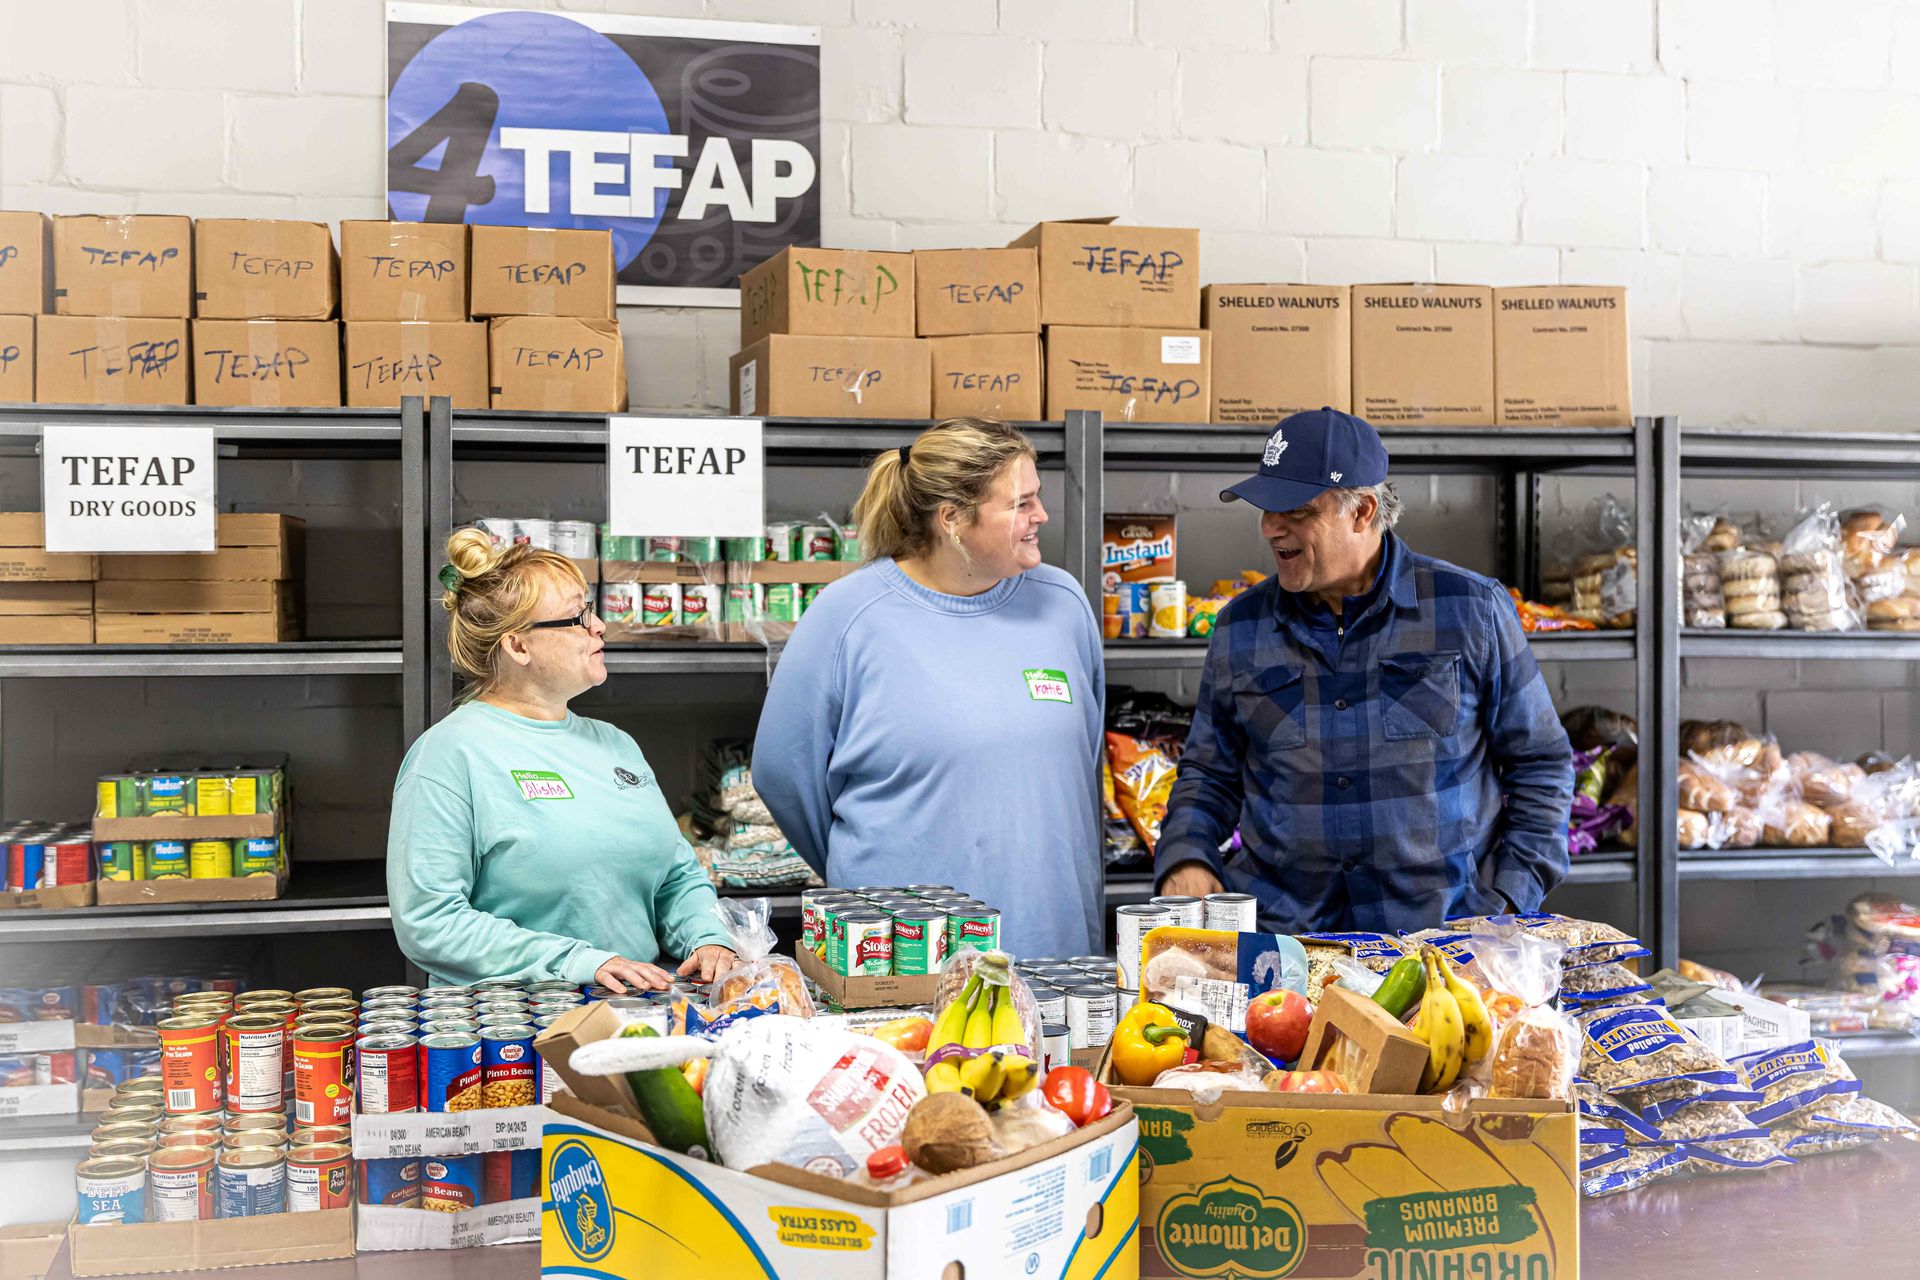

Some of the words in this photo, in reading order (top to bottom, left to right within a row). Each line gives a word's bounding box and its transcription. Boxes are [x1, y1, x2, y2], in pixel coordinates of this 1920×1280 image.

[388, 82, 499, 224] 4
[500, 126, 816, 223] TEFAP
[81, 246, 178, 271] TEFAP
[231, 251, 313, 279] TEFAP
[364, 255, 455, 281] TEFAP
[1082, 246, 1183, 281] TEFAP
[499, 262, 586, 285] TEFAP
[941, 282, 1024, 305] TEFAP
[1219, 296, 1274, 308] SHELLED
[1278, 297, 1340, 308] WALNUTS
[1365, 297, 1419, 308] SHELLED
[1423, 297, 1482, 308] WALNUTS
[1501, 299, 1554, 310] SHELLED
[1557, 297, 1616, 309] WALNUTS
[512, 347, 603, 371] TEFAP
[352, 353, 442, 389] TEFAP
[946, 372, 1021, 392] TEFAP
[1100, 375, 1200, 403] TEFAP
[62, 456, 195, 486] TEFAP
[626, 446, 746, 476] TEFAP
[70, 500, 115, 517] DRY
[121, 500, 196, 517] GOODS
[1105, 540, 1170, 564] Instant
[153, 780, 182, 790] Hudson
[520, 780, 566, 798] Alisha
[155, 844, 184, 854] Hudson
[249, 841, 275, 851] Hudson
[963, 922, 993, 933] Stokely's
[1743, 1013, 1779, 1033] PAGHETTI
[1599, 1023, 1675, 1050] WALNUTS
[503, 1047, 522, 1055] American
[487, 1069, 510, 1079] Pinto
[511, 1068, 534, 1076] Beans
[1749, 1051, 1820, 1079] WALNUTS
[460, 1074, 479, 1087] Pinto
[727, 1071, 746, 1127] frozen
[859, 1077, 918, 1150] FROZEN
[425, 1128, 451, 1138] AMERICAN
[452, 1125, 471, 1138] BEAUTY
[389, 1145, 404, 1155] PINTO
[405, 1144, 422, 1155] BEANS
[331, 1167, 345, 1179] Pink
[551, 1159, 602, 1204] Chiquita
[87, 1185, 129, 1198] DEEP
[434, 1187, 463, 1198] Beans
[92, 1199, 122, 1211] SEA
[1205, 1202, 1257, 1222] Quality
[1400, 1194, 1499, 1221] BANANAS
[488, 1214, 514, 1226] AMERICAN
[516, 1211, 535, 1223] BEAUTY
[779, 1214, 818, 1229] EXTRA
[820, 1218, 857, 1232] CLASS
[781, 1232, 818, 1246] QUALITY
[1168, 1222, 1249, 1250] Monte
[1252, 1226, 1293, 1252] Del
[1404, 1215, 1500, 1243] PREMIUM
[467, 1233, 484, 1246] BEANS
[819, 1235, 863, 1249] SELECTED
